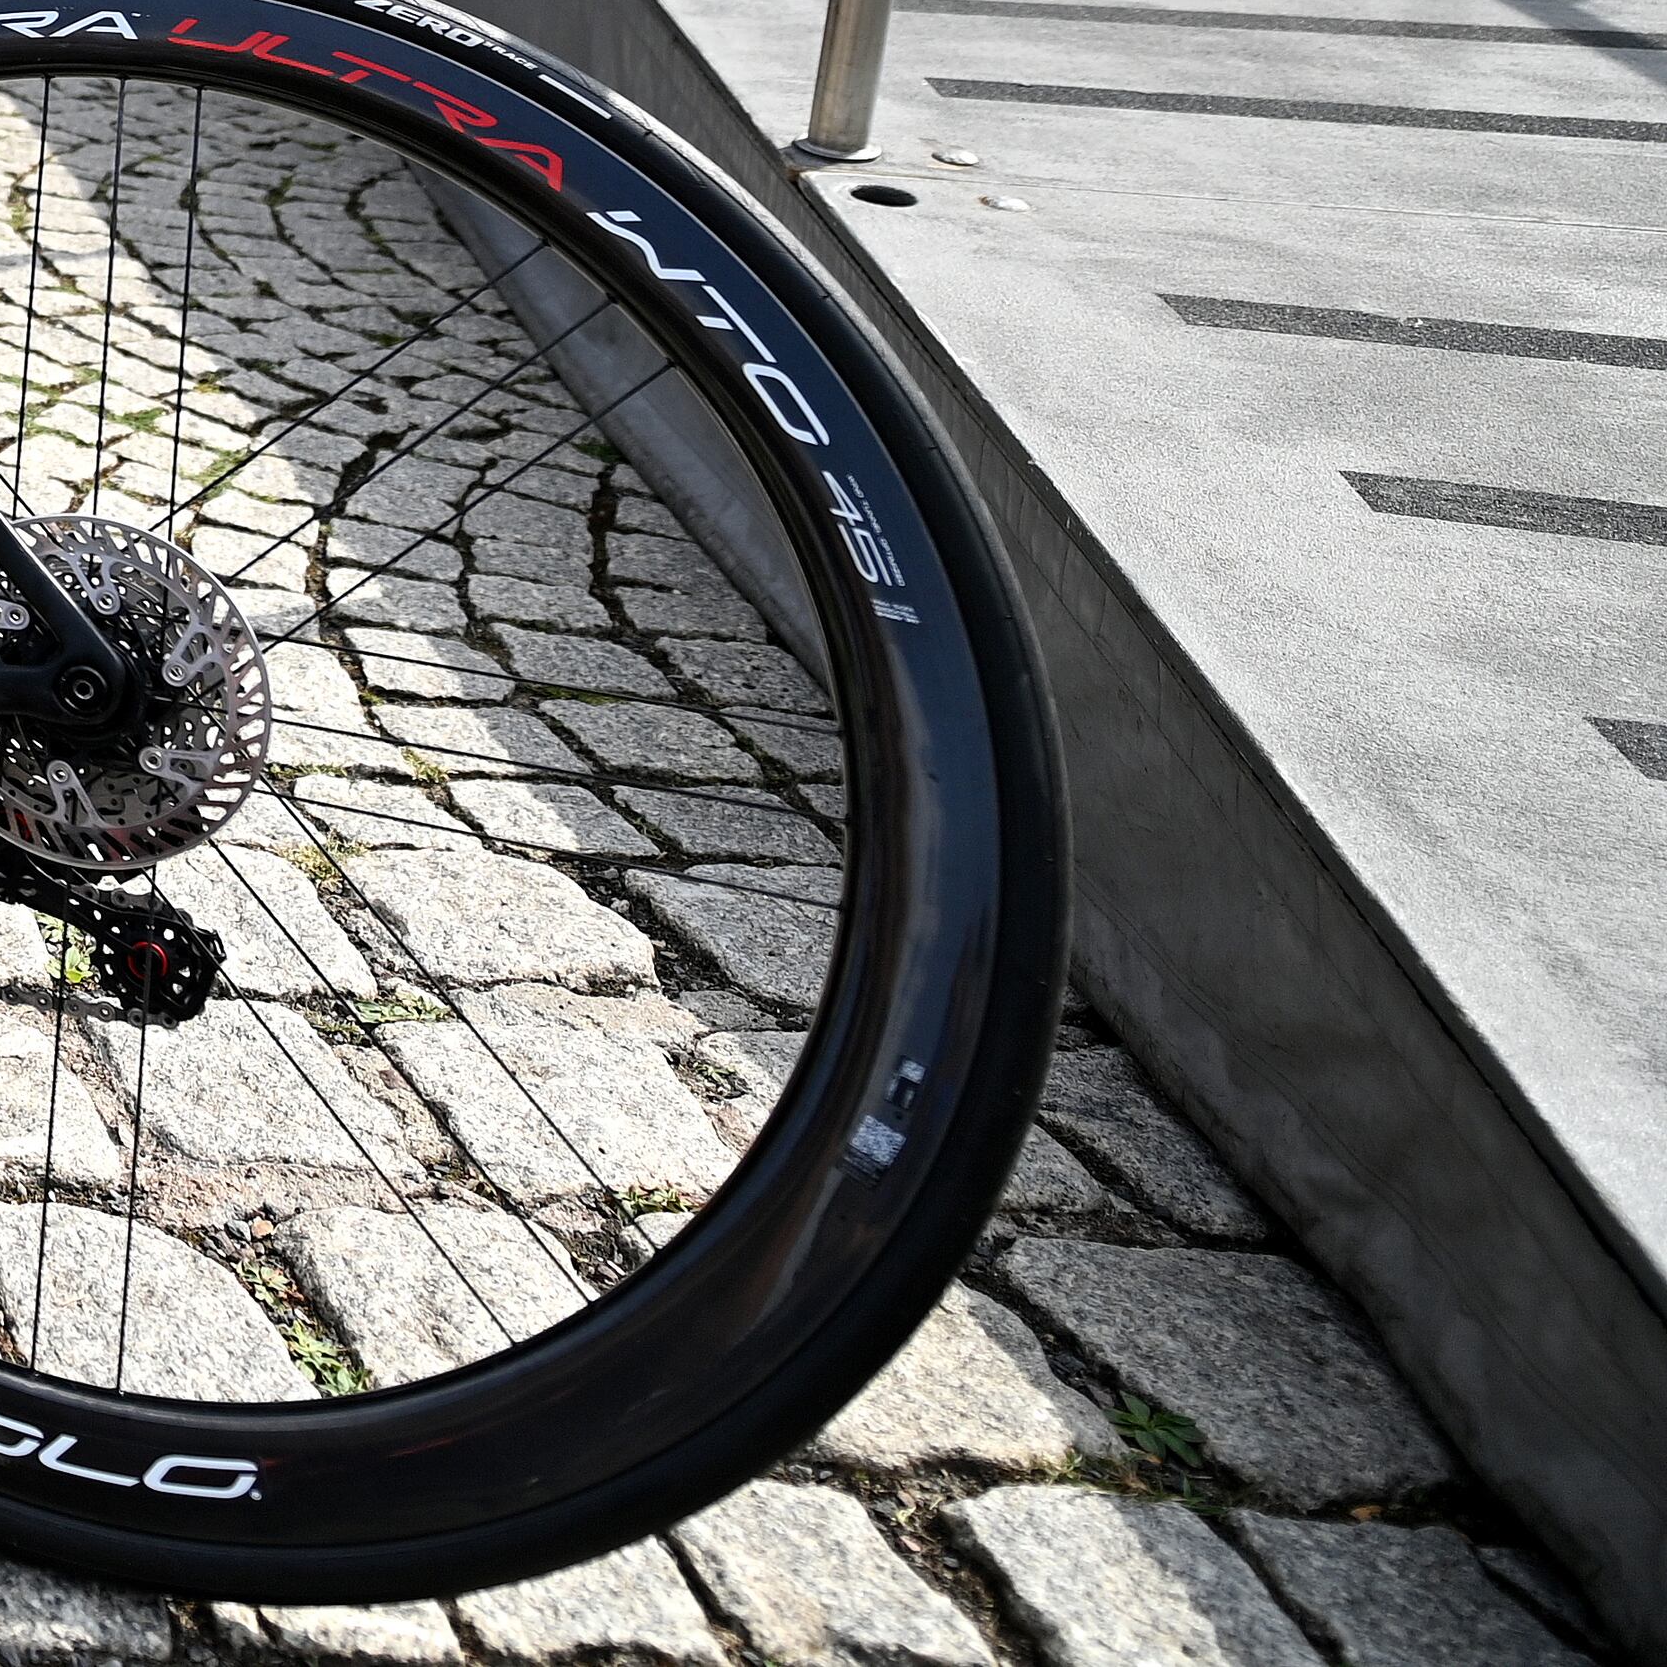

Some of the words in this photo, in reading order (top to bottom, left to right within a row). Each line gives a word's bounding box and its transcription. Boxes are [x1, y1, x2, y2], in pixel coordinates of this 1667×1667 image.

[166, 16, 564, 192] ULTRA
[491, 46, 539, 71] RACE
[585, 209, 830, 447] WTO
[821, 469, 893, 587] 45
